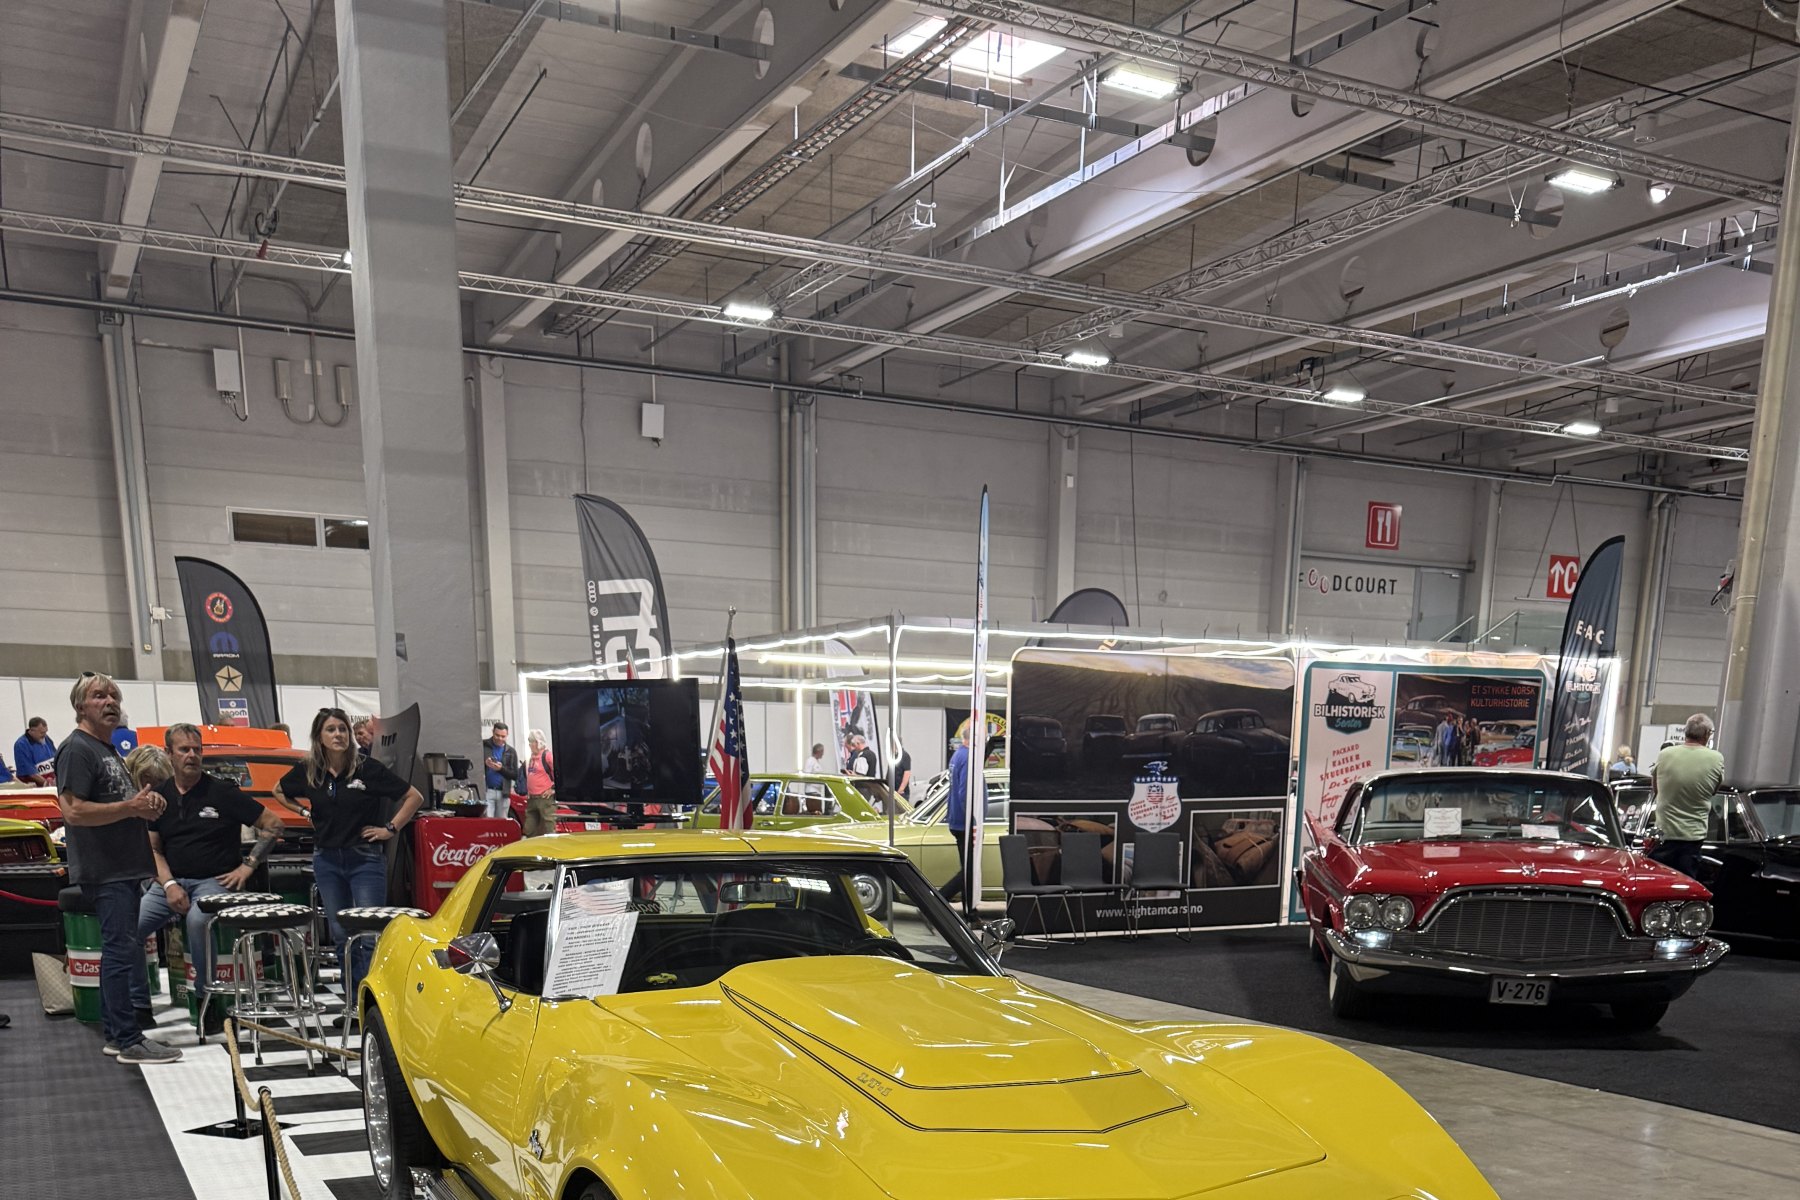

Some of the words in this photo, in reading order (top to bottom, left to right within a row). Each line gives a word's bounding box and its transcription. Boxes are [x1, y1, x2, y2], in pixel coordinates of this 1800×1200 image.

[1471, 685, 1481, 694] ET
[1482, 685, 1510, 695] STYKKE
[1511, 686, 1536, 695] NORSK
[1470, 698, 1530, 708] KULTURHISTORIE
[1314, 704, 1385, 719] BILHISTORISK
[1334, 718, 1363, 729] Senter
[1332, 743, 1360, 757] PACKARD
[1332, 754, 1361, 768] KAISER
[1320, 760, 1373, 782] STUDEBAKER
[1496, 981, 1546, 1000] V-276
